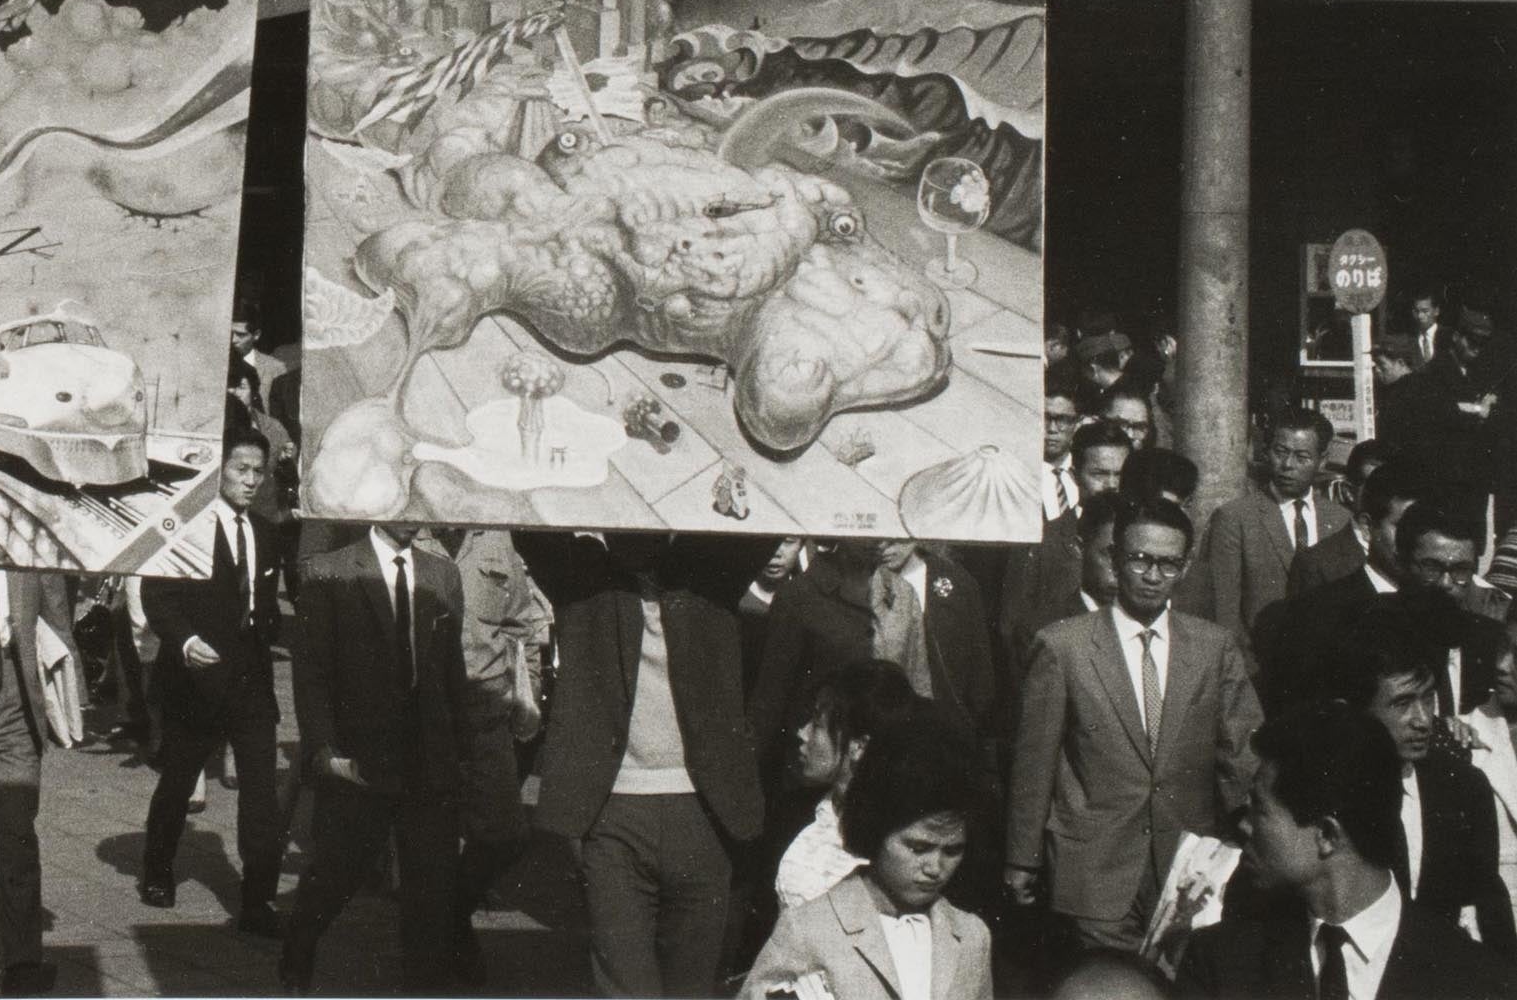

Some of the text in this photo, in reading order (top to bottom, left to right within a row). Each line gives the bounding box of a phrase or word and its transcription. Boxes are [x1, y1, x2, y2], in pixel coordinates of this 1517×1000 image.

[1339, 254, 1376, 266] タクシー
[1336, 266, 1382, 288] のりば
